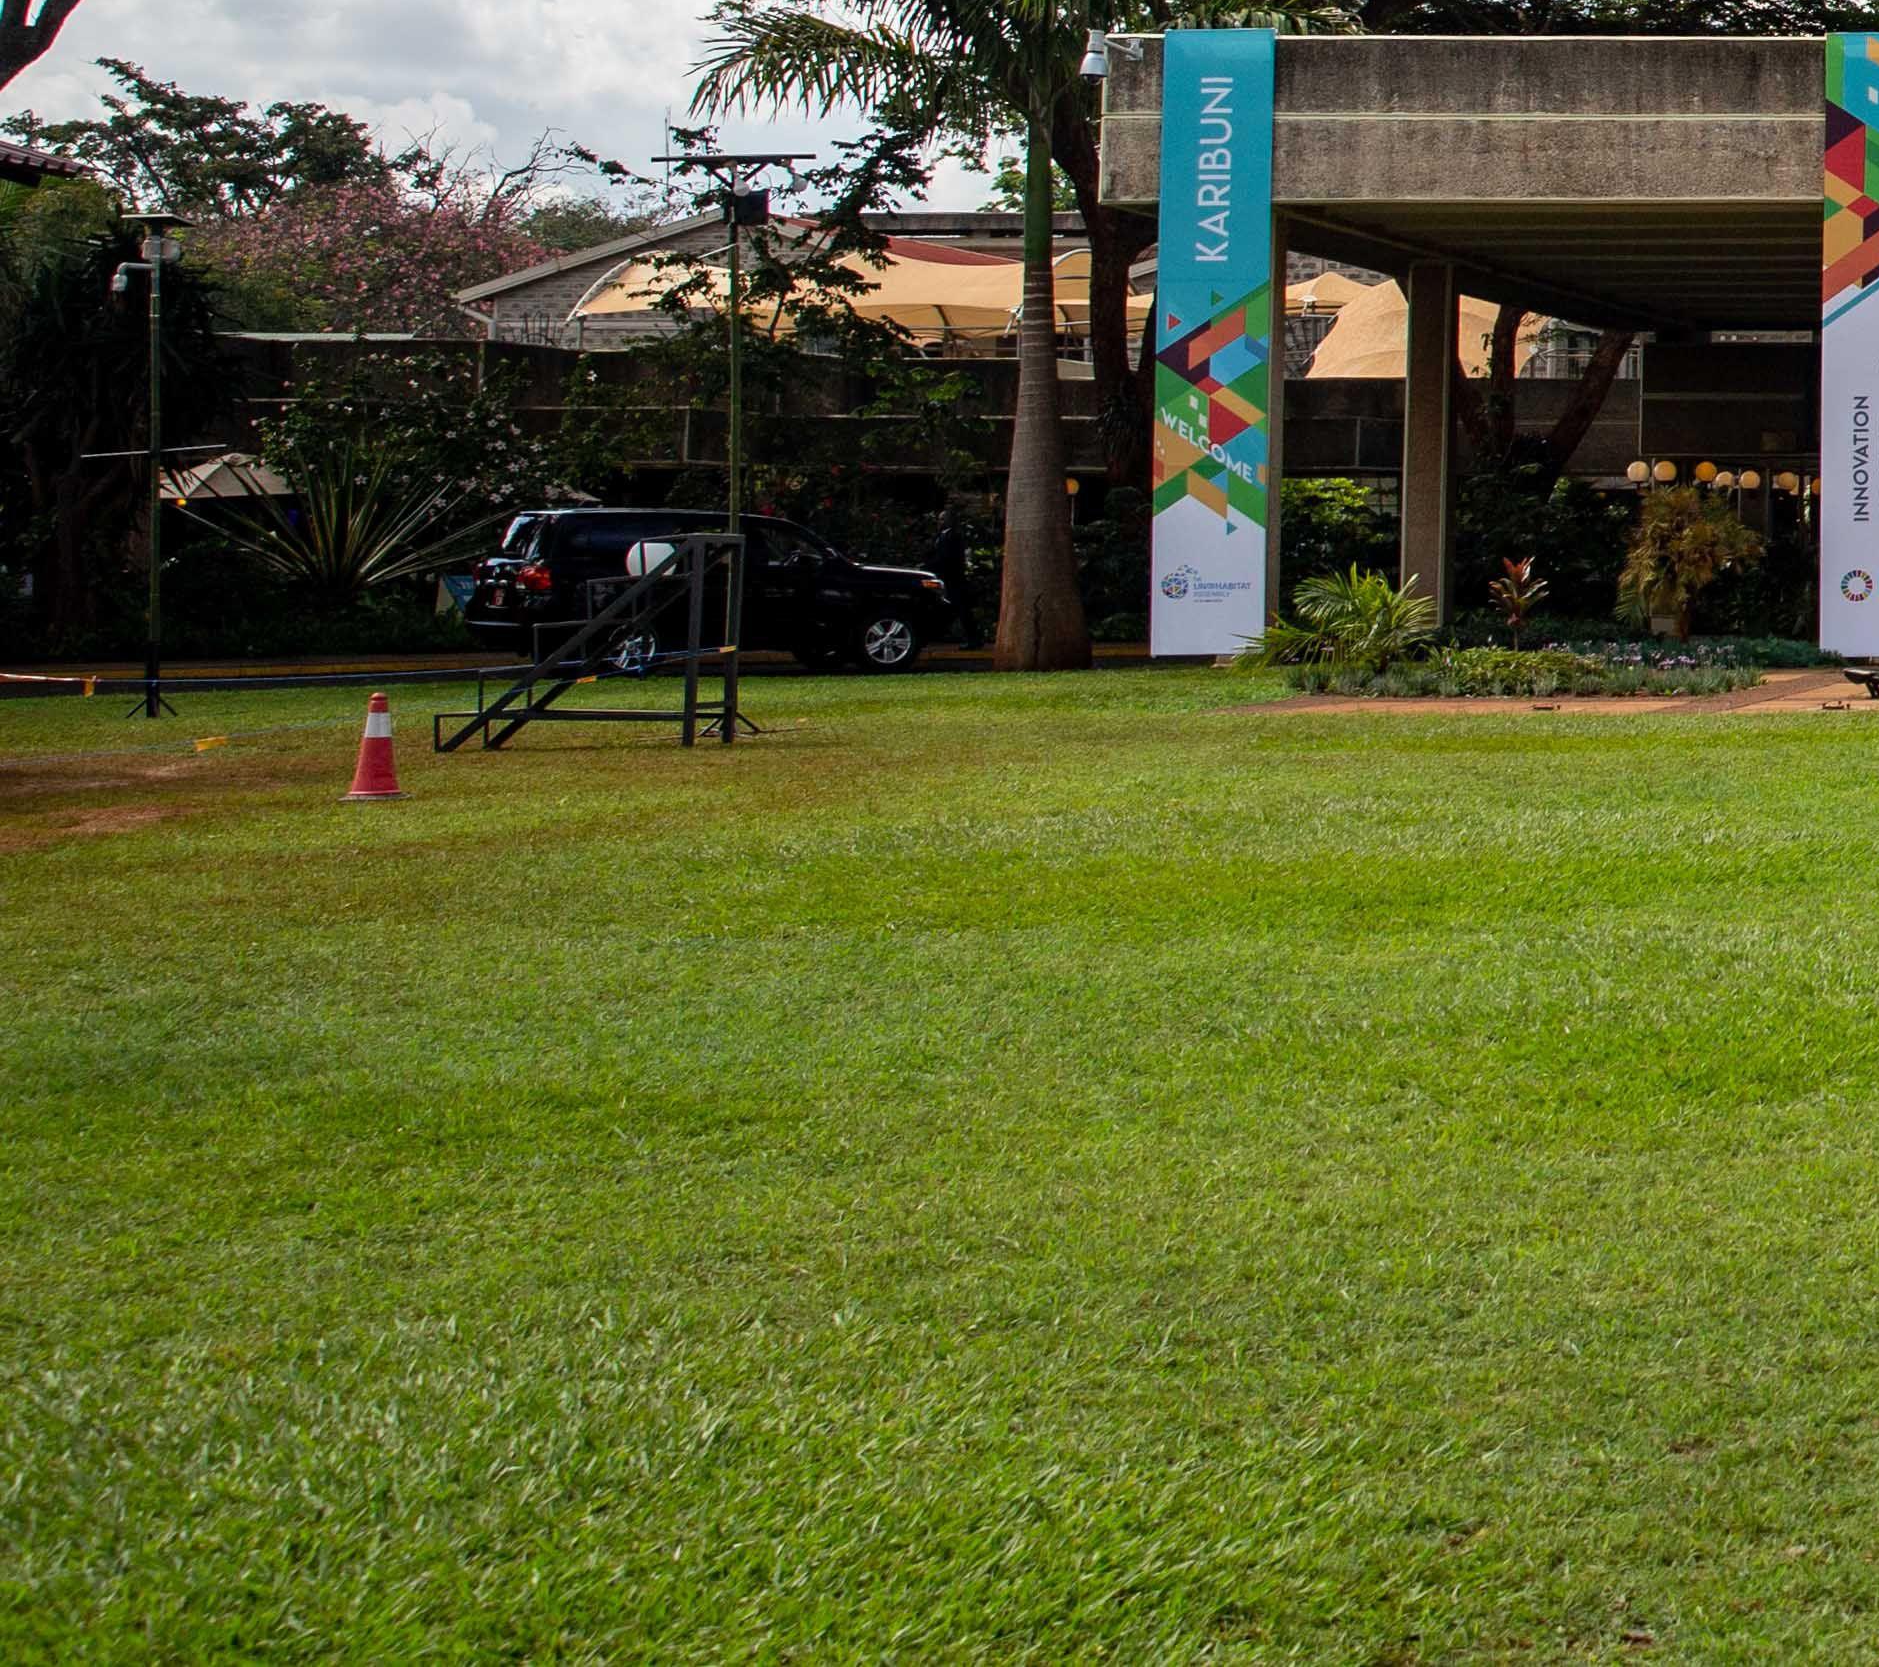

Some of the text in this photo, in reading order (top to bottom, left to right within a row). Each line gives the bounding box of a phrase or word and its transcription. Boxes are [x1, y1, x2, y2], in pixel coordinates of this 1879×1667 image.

[1195, 77, 1234, 262] KARIBUNI
[1161, 406, 1253, 484] WELCOME
[1853, 396, 1869, 522] INNOVATION
